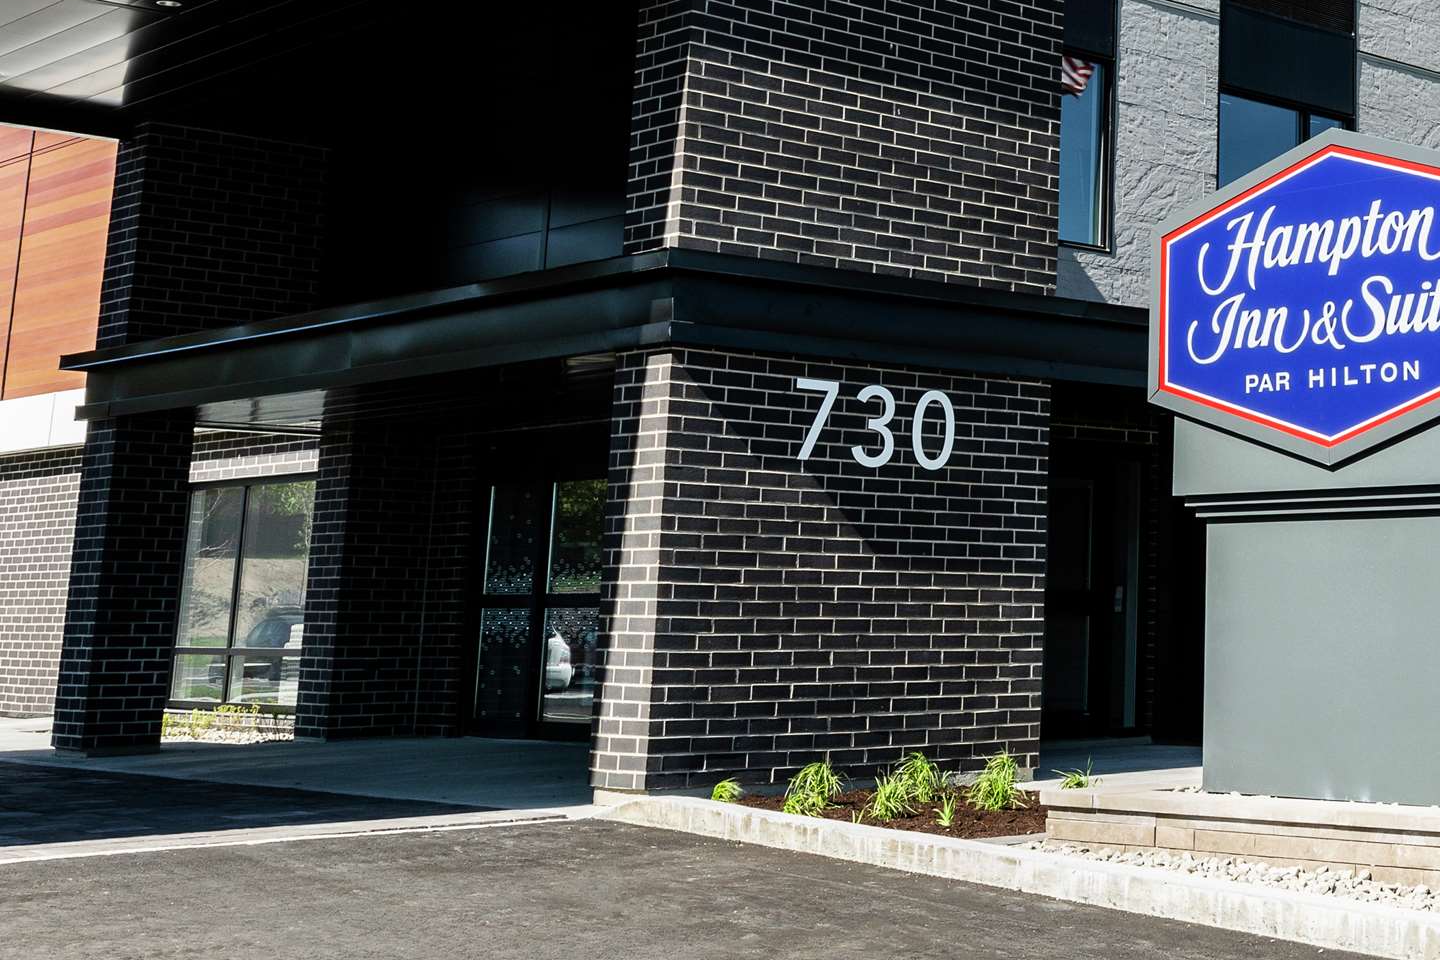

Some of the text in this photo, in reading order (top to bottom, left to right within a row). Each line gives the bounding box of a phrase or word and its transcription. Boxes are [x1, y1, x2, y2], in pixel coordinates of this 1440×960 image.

[1187, 292, 1310, 365] Inn
[1312, 301, 1345, 350] &
[1245, 359, 1420, 394] PAR HILTON
[796, 378, 956, 471] 730
